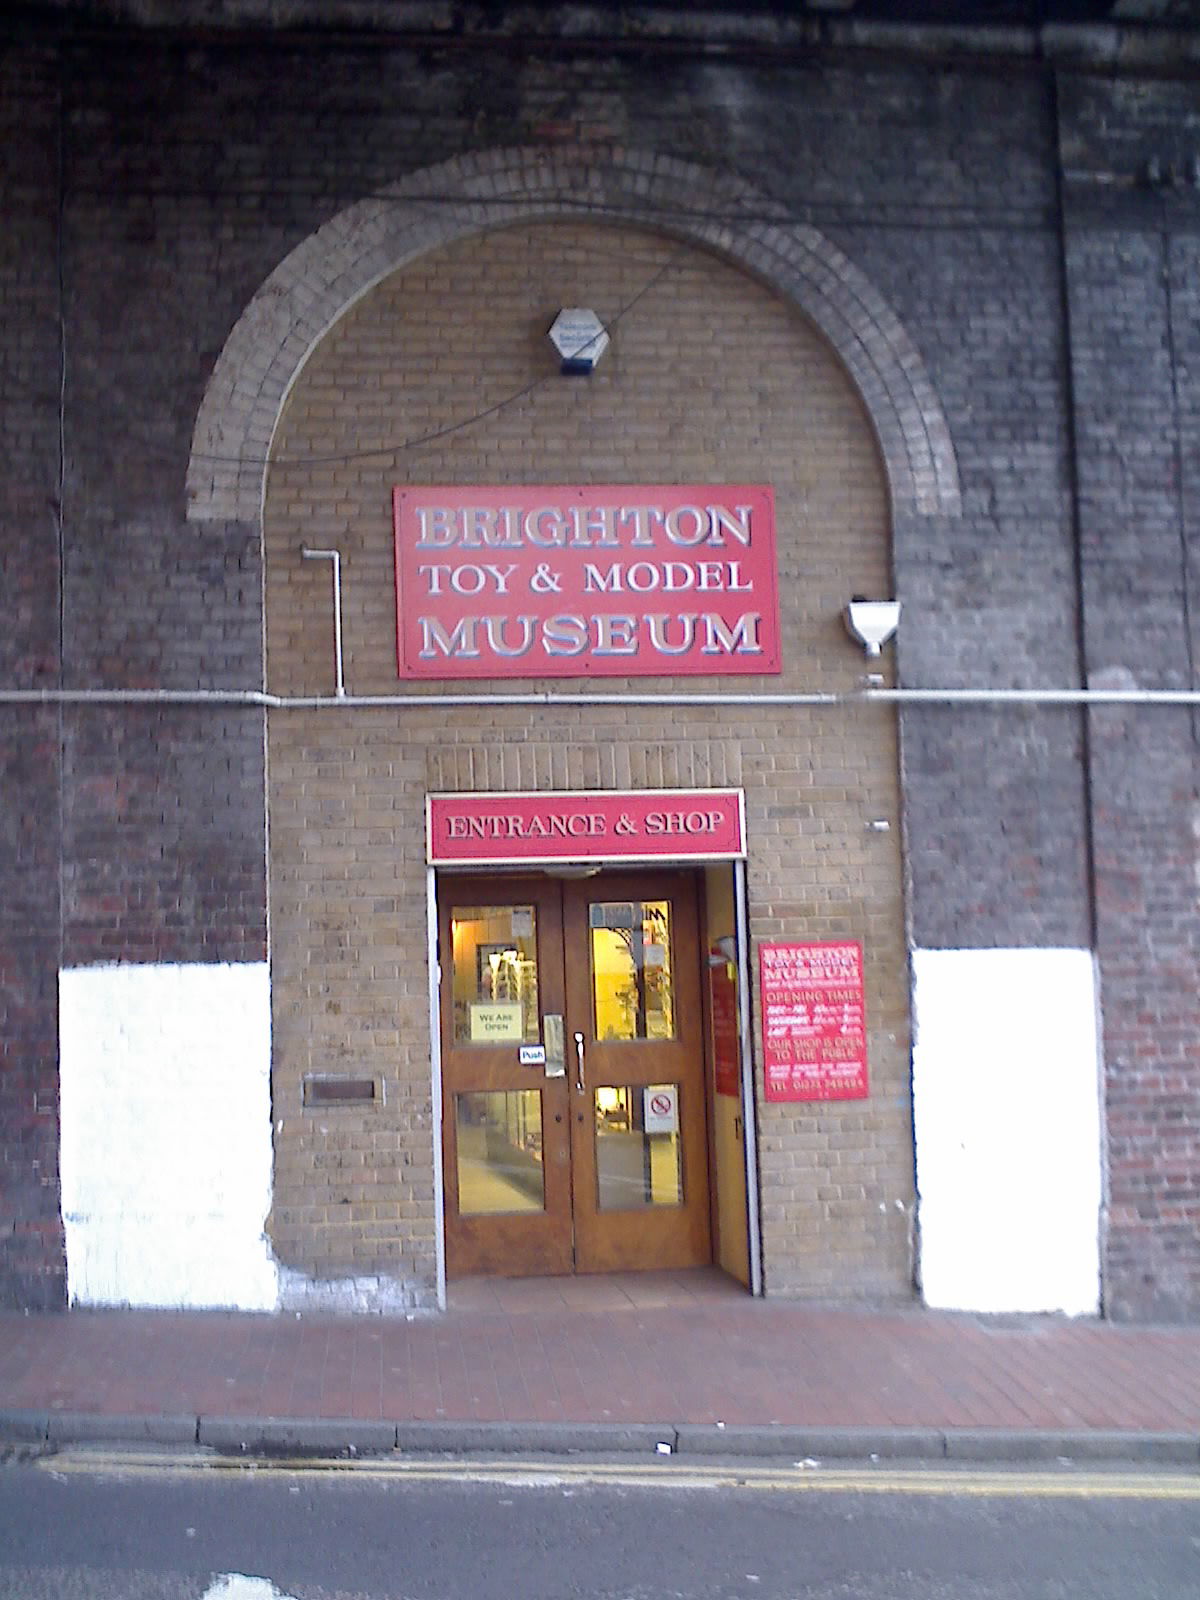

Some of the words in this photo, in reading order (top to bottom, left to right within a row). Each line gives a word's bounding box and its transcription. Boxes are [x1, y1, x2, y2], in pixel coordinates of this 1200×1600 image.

[415, 504, 753, 549] BRIGHTON
[419, 563, 518, 594] TOY
[530, 562, 562, 593] &
[584, 561, 753, 593] MODEL
[418, 612, 763, 658] MUSEUM
[446, 814, 605, 839] ENTRANCE
[614, 812, 637, 835] &
[645, 811, 724, 835] SHOP
[763, 947, 859, 960] BRIGHTON
[765, 959, 791, 968] TOY
[809, 958, 859, 967] MODEL
[764, 967, 859, 980] MUSEUM
[766, 990, 823, 1003] OPENING
[826, 989, 861, 1001] TIMES
[485, 1023, 508, 1031] OPEN
[767, 1039, 791, 1050] OUR
[793, 1038, 819, 1049] SHOP
[834, 1037, 864, 1048] OPEN
[523, 1051, 543, 1059] Push
[774, 1050, 791, 1061] TO
[796, 1049, 817, 1061] THE
[822, 1048, 857, 1059] PUBLIC
